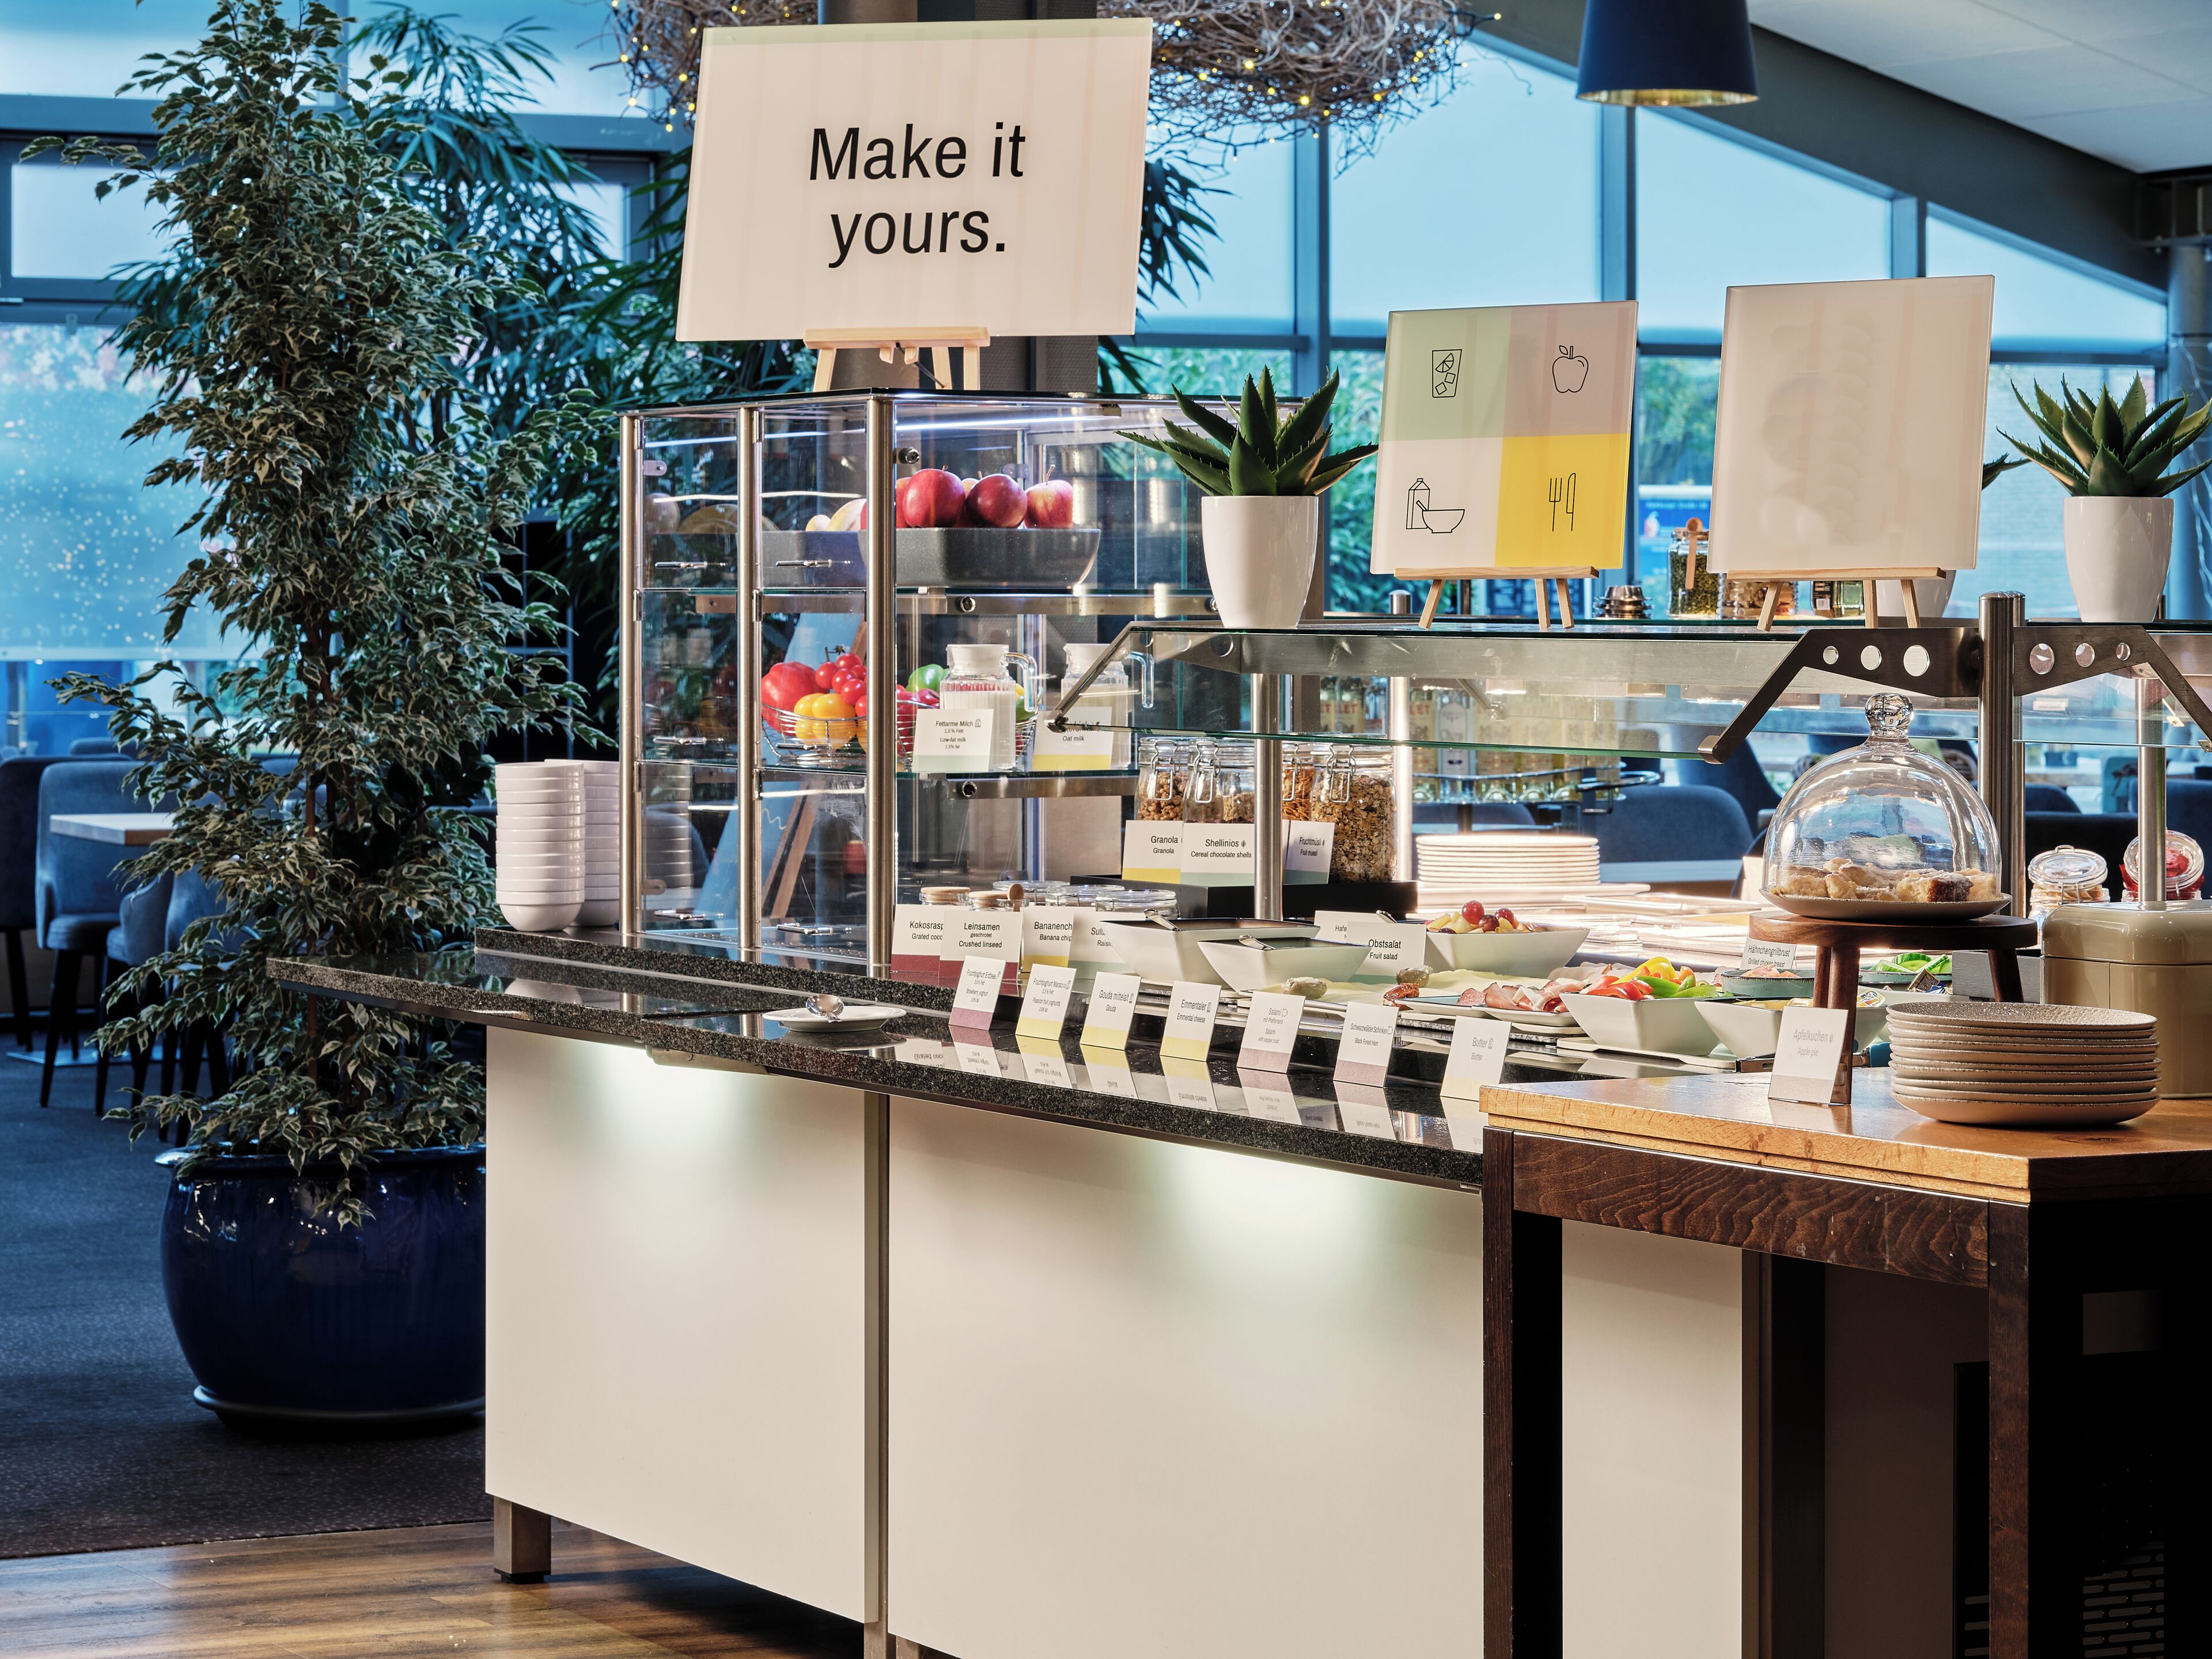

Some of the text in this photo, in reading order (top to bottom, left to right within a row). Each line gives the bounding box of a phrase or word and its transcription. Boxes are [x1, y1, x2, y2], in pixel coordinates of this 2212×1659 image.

[809, 122, 1027, 180] Make it
[828, 210, 1006, 268] yours.
[1205, 839, 1239, 847] Shellinios
[964, 922, 1000, 930] Leinsamen
[1034, 922, 1073, 930] Bananench
[1368, 939, 1401, 949] Obstsalat
[1748, 945, 1790, 957] Hähnchengrillbrust
[1099, 990, 1129, 1001] Gouda mittelalt
[1105, 1004, 1116, 1012] Gouda
[1181, 999, 1207, 1010] Emmentaler
[1268, 1007, 1282, 1016] Salami
[1177, 1013, 1194, 1021] Emmental
[1350, 1023, 1388, 1035] Schwarzwälder Schinken
[1793, 1029, 1828, 1042] Apfelkuchen
[1472, 1037, 1488, 1048] Butter
[1471, 1052, 1483, 1060] Butter
[1797, 1047, 1810, 1057] Apple
